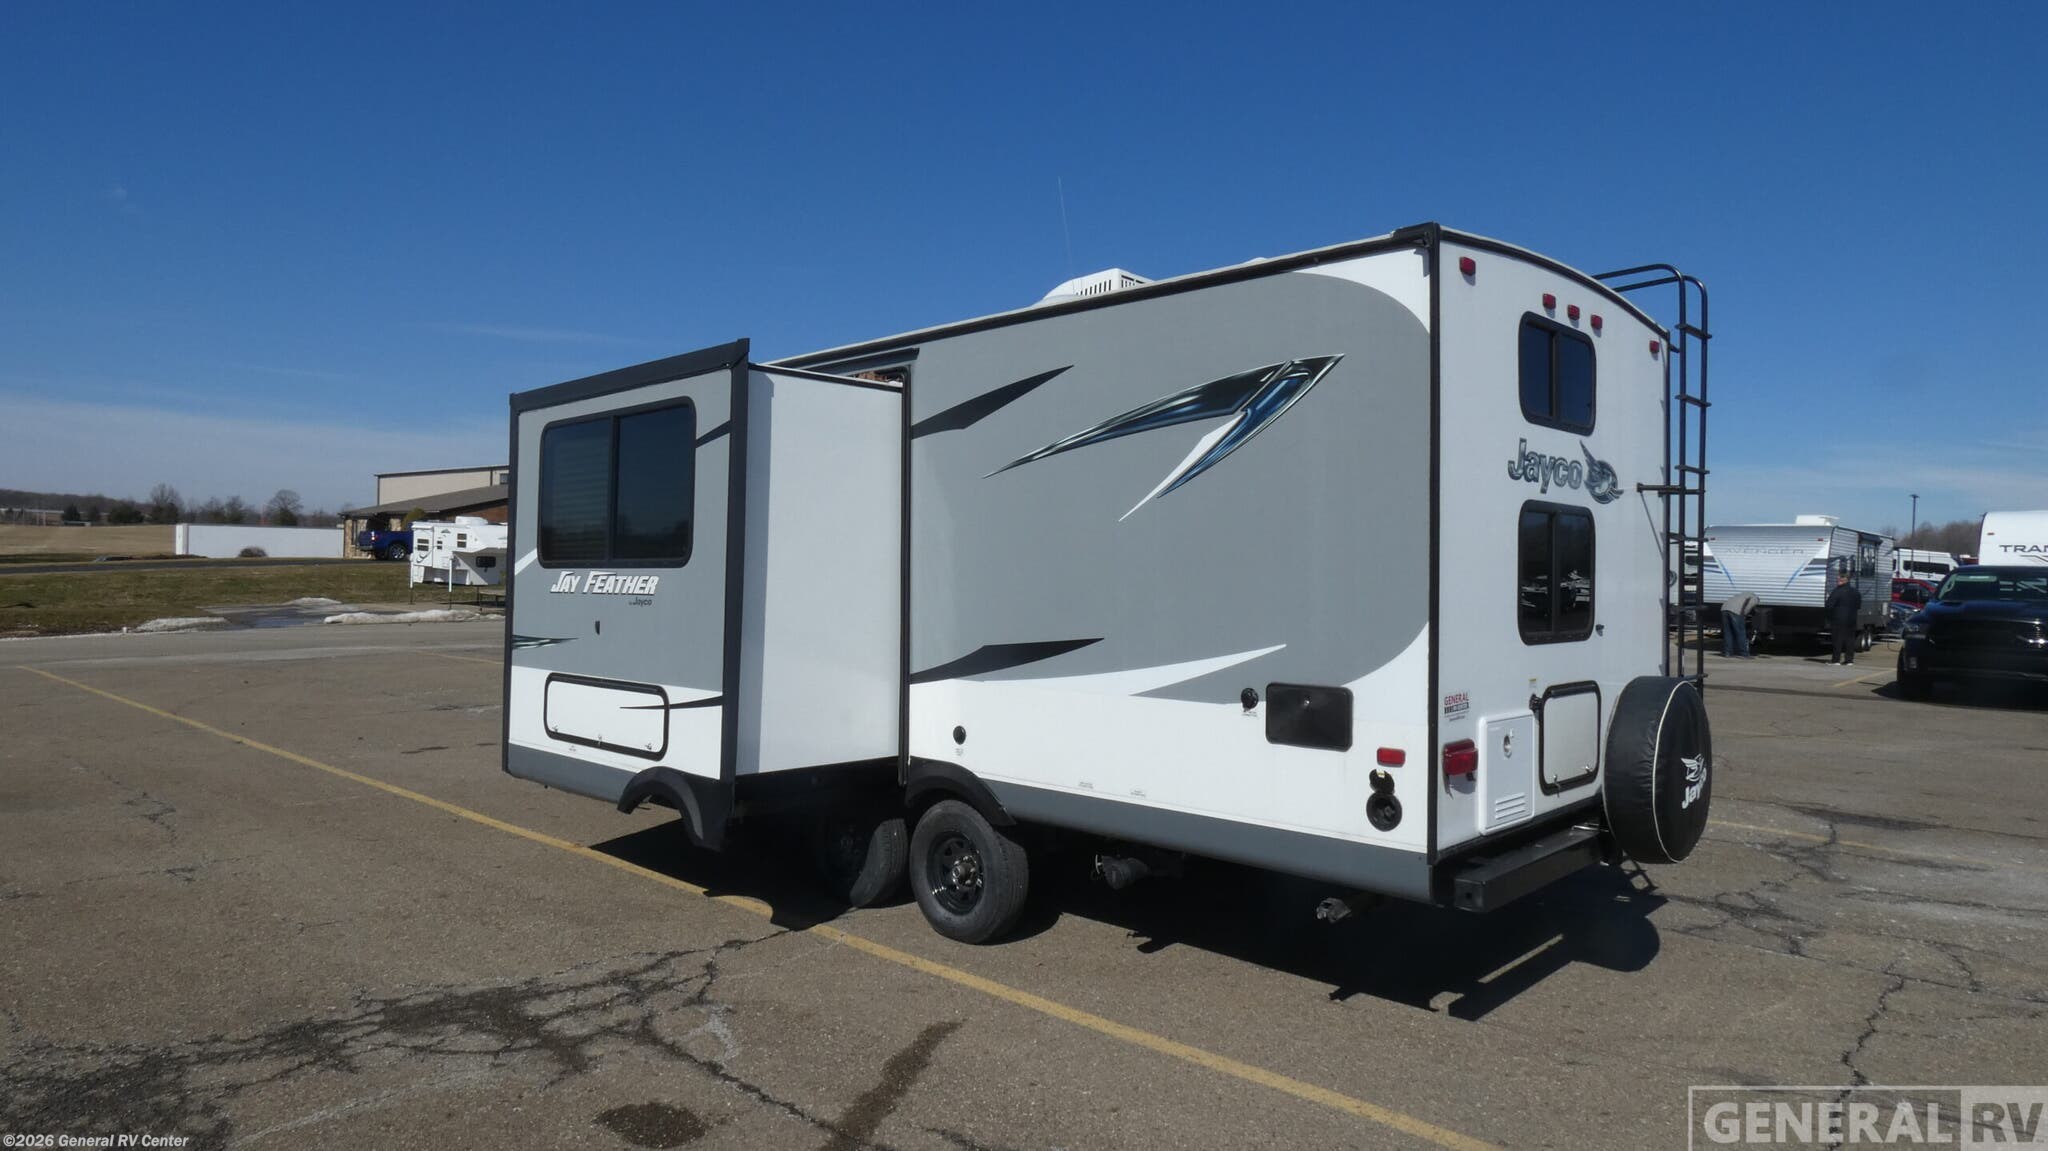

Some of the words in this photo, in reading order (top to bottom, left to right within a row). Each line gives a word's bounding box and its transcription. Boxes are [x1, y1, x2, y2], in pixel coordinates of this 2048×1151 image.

[1507, 437, 1583, 494] Jayco
[550, 570, 581, 594] JAY
[582, 570, 660, 596] FEATHER
